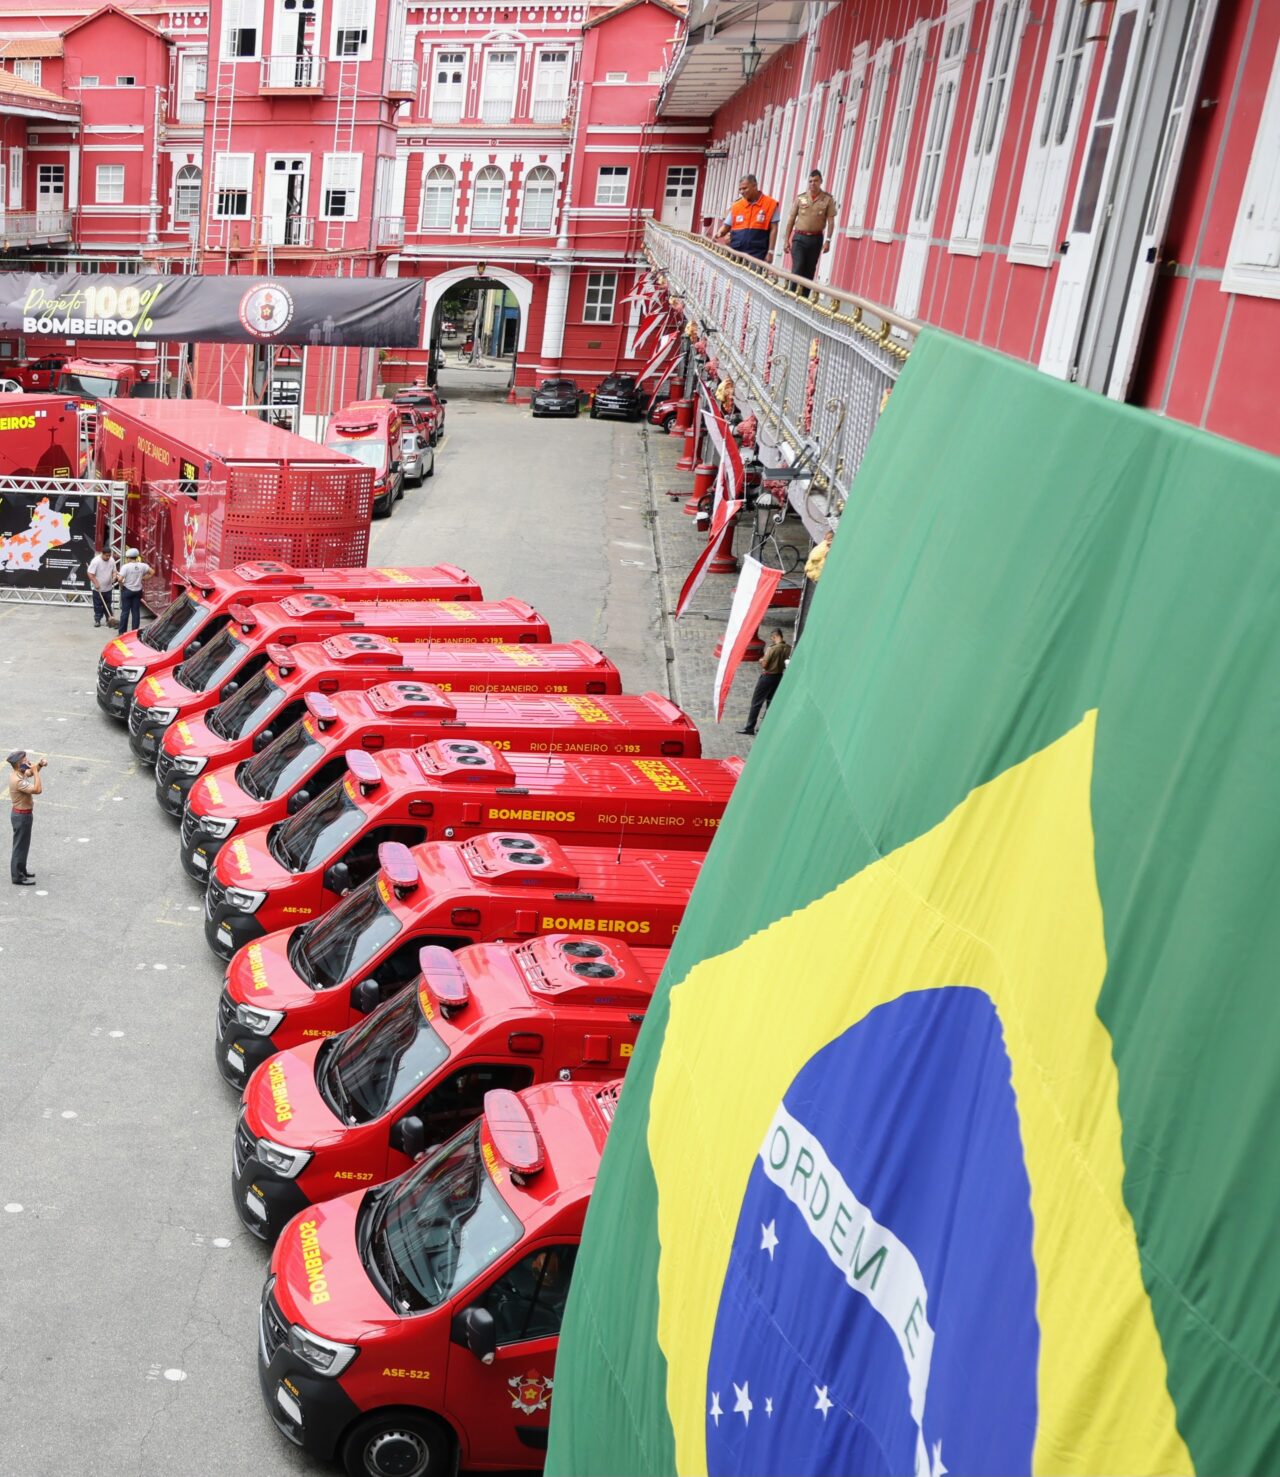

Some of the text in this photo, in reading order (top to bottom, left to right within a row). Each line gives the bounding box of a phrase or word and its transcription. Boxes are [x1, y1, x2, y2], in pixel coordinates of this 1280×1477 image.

[23, 283, 163, 338] Projeto 100%
[23, 317, 134, 336] BOMBEIRO
[500, 685, 538, 693] JANEIRO
[553, 685, 568, 693] 193
[530, 743, 640, 753] RIO DE JANEIRO 193
[488, 809, 576, 822] BOMBEIROS
[598, 814, 618, 824] RIO
[620, 815, 635, 825] DE
[637, 816, 685, 826] JANEIRO
[542, 917, 651, 933] BOMBEIROS
[334, 1171, 373, 1181] ASE-527
[768, 1125, 924, 1360] ORDEM E
[382, 1368, 431, 1380] ASE-522
